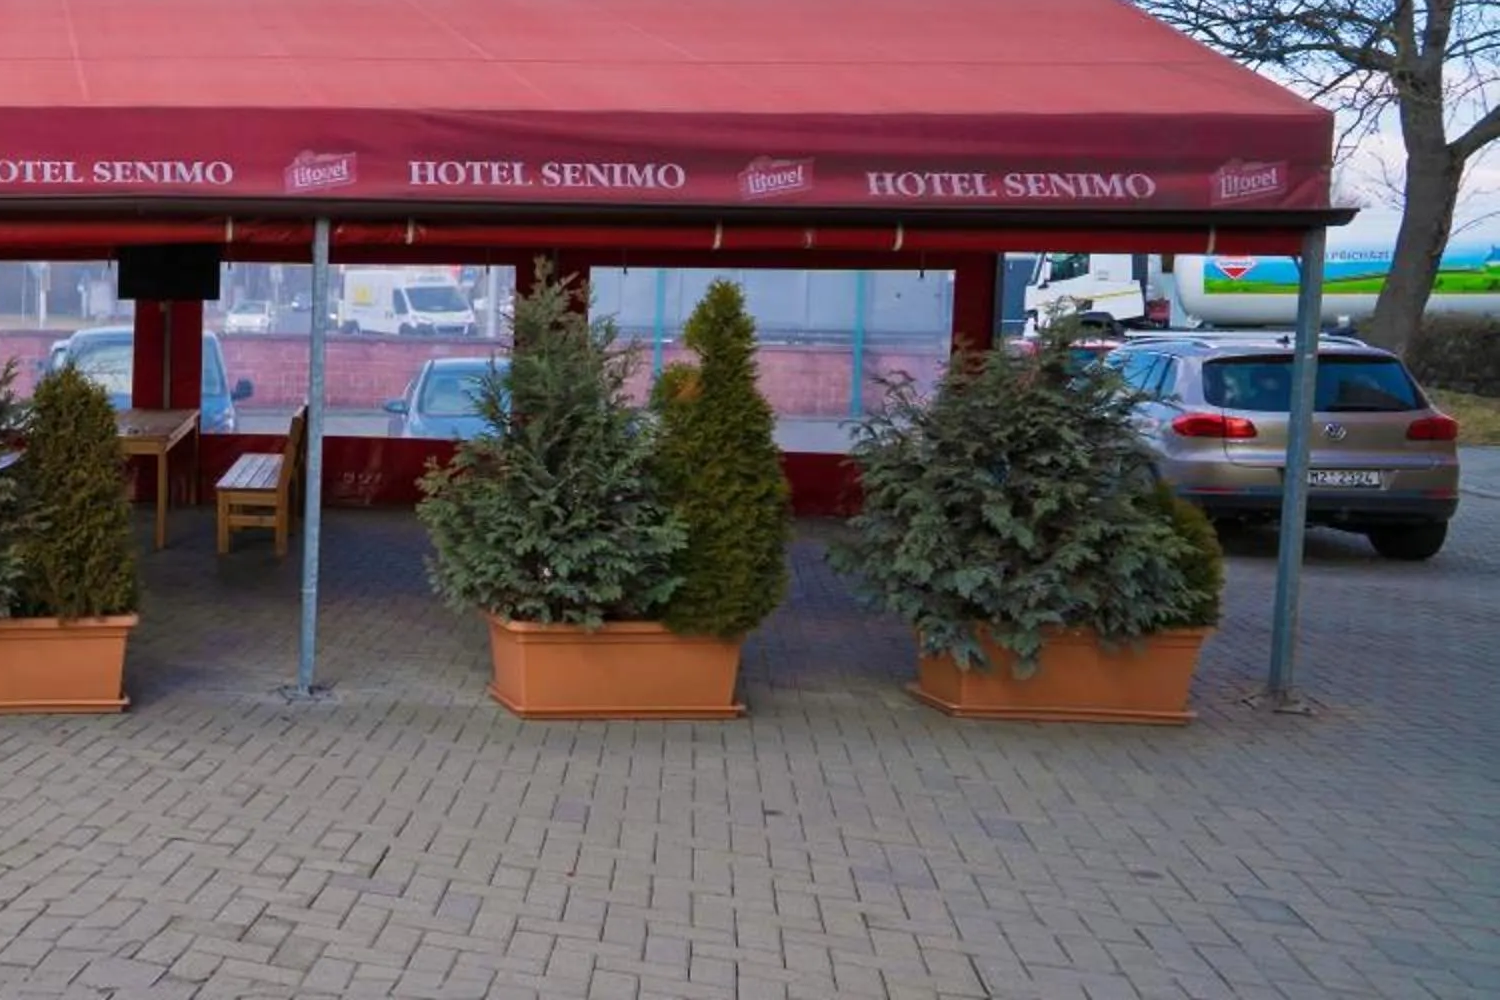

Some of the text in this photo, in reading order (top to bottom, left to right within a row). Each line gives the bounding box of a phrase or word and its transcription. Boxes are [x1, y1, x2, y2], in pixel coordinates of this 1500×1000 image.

[92, 160, 234, 186] SENIMO
[408, 161, 686, 189] HOTEL SENIMO
[866, 171, 1156, 199] HOTEL SENIMO
